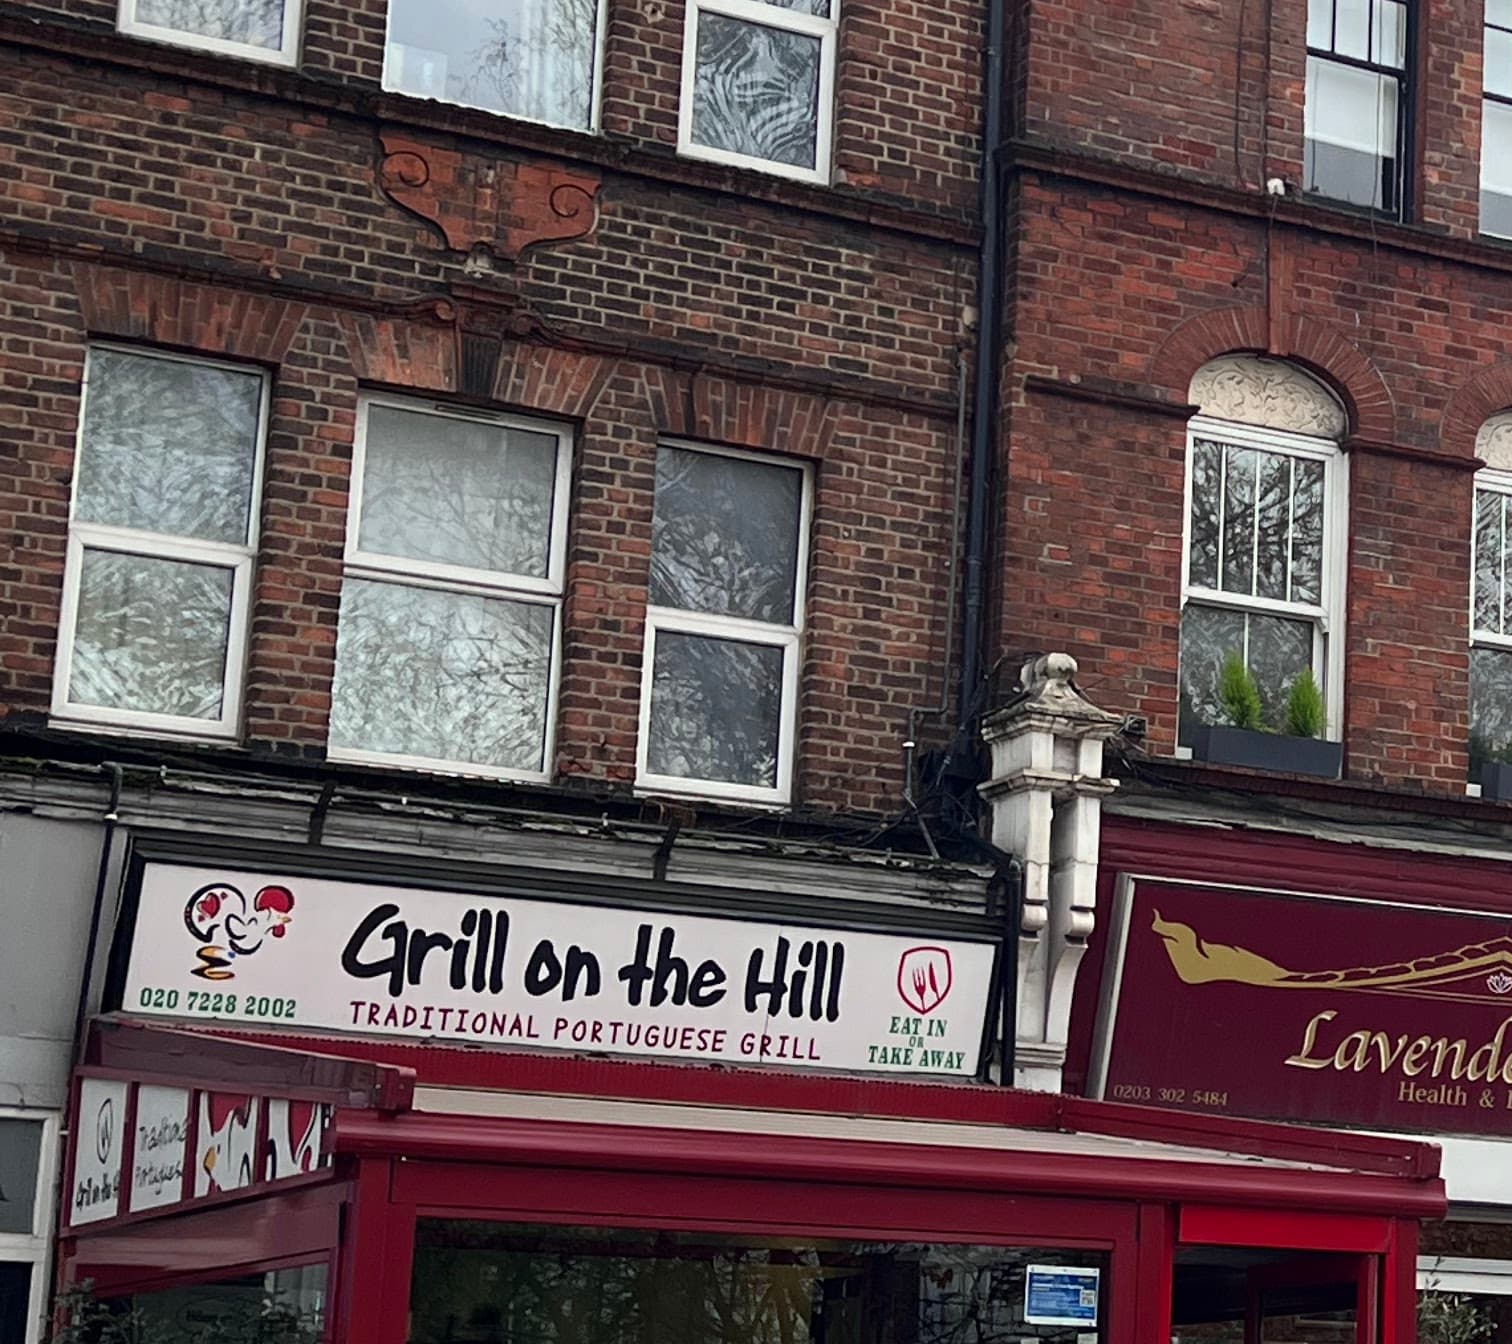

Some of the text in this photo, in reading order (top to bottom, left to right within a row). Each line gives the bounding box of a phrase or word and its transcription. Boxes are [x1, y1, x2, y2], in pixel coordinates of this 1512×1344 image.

[342, 904, 844, 1022] Grill on the Hill
[140, 987, 297, 1018] 020 7228 2002
[350, 1001, 821, 1061] TRADITIONAL PORTUGUESE GRILL
[889, 1016, 947, 1037] EAT IN
[909, 1036, 924, 1048] OR
[868, 1045, 965, 1070] TAKE AWAY
[1113, 1084, 1228, 1105] 0203 302 5484
[1398, 1081, 1468, 1107] Health
[1479, 1090, 1495, 1108] &
